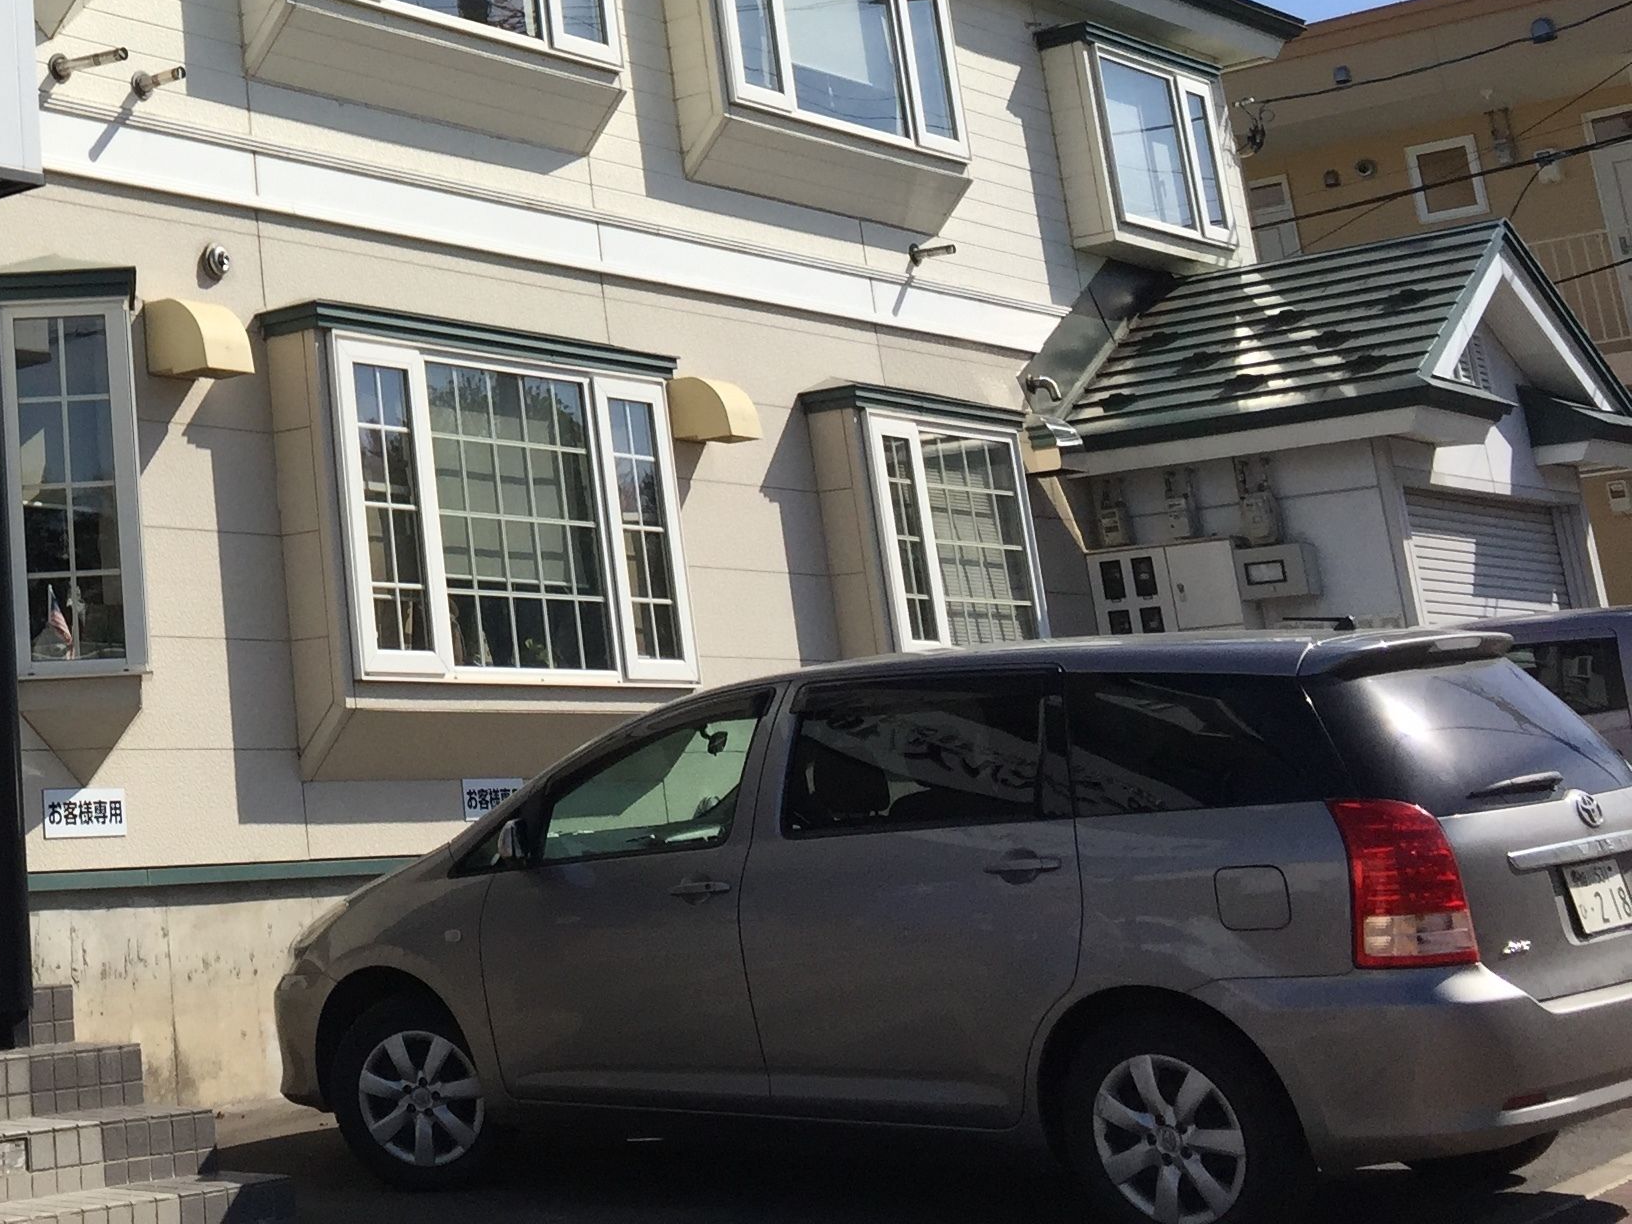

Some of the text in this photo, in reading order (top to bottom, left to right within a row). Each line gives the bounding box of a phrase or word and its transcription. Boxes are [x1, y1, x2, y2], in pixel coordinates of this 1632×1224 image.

[466, 787, 518, 811] お客様専
[47, 800, 124, 826] お客様専用
